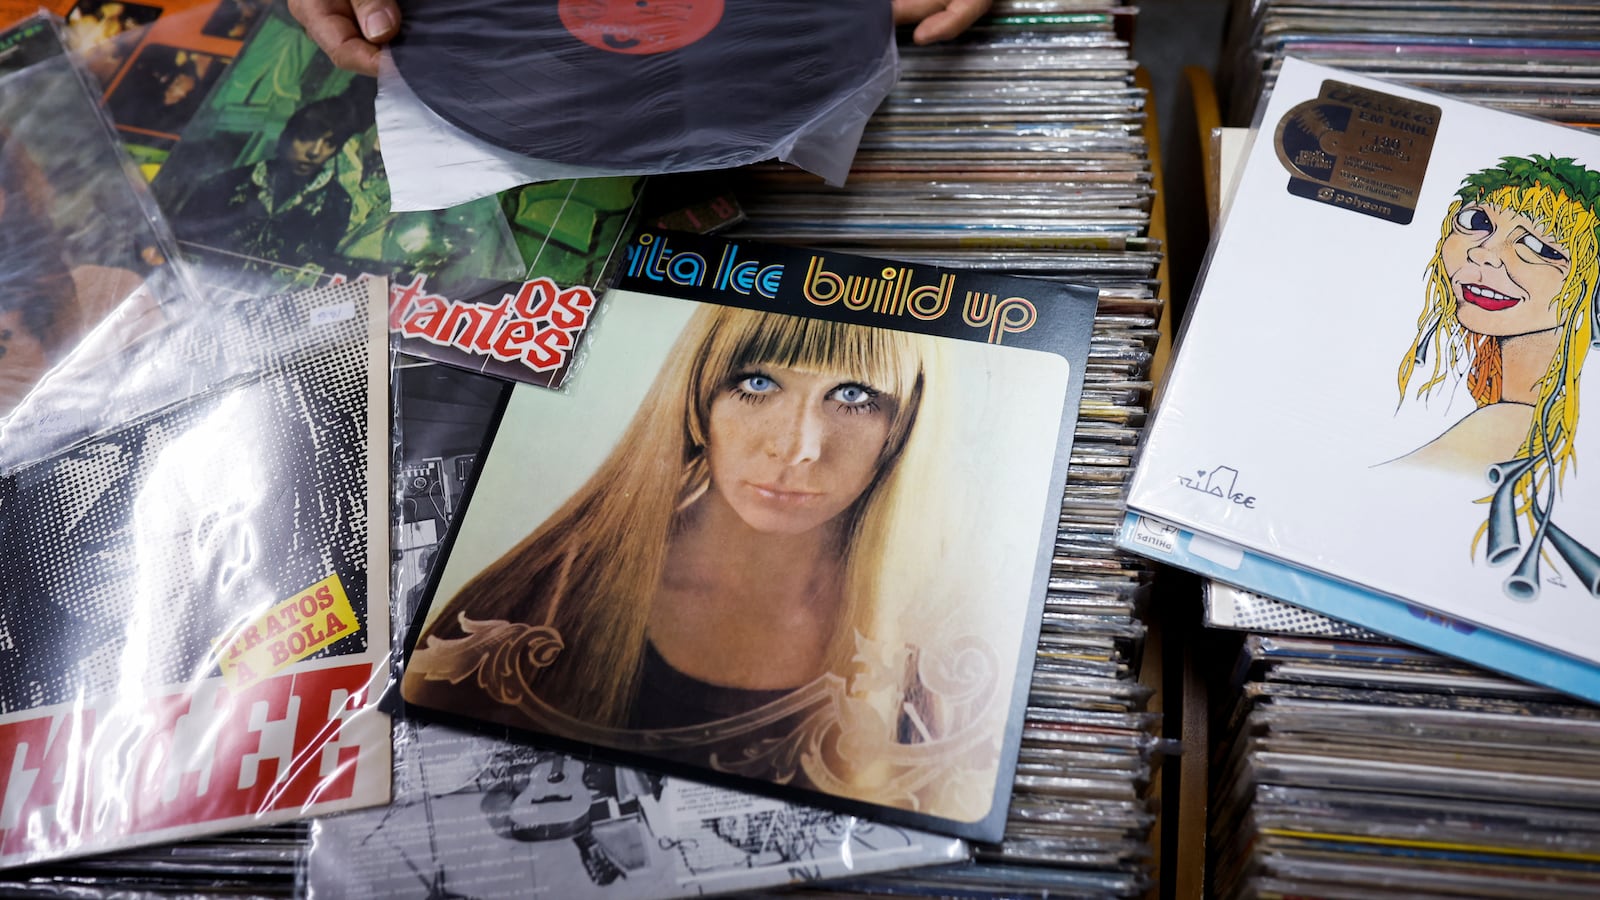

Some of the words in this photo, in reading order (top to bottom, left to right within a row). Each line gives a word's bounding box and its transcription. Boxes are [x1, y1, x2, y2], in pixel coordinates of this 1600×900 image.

[1359, 111, 1384, 125] EM
[1390, 117, 1430, 137] VINIL
[1336, 194, 1392, 216] polysom
[712, 241, 786, 300] lee
[803, 256, 956, 321] build
[962, 291, 1038, 345] up
[1137, 532, 1172, 551] PHILIPS
[220, 585, 335, 661] TRATOS
[266, 611, 348, 667] BOLA
